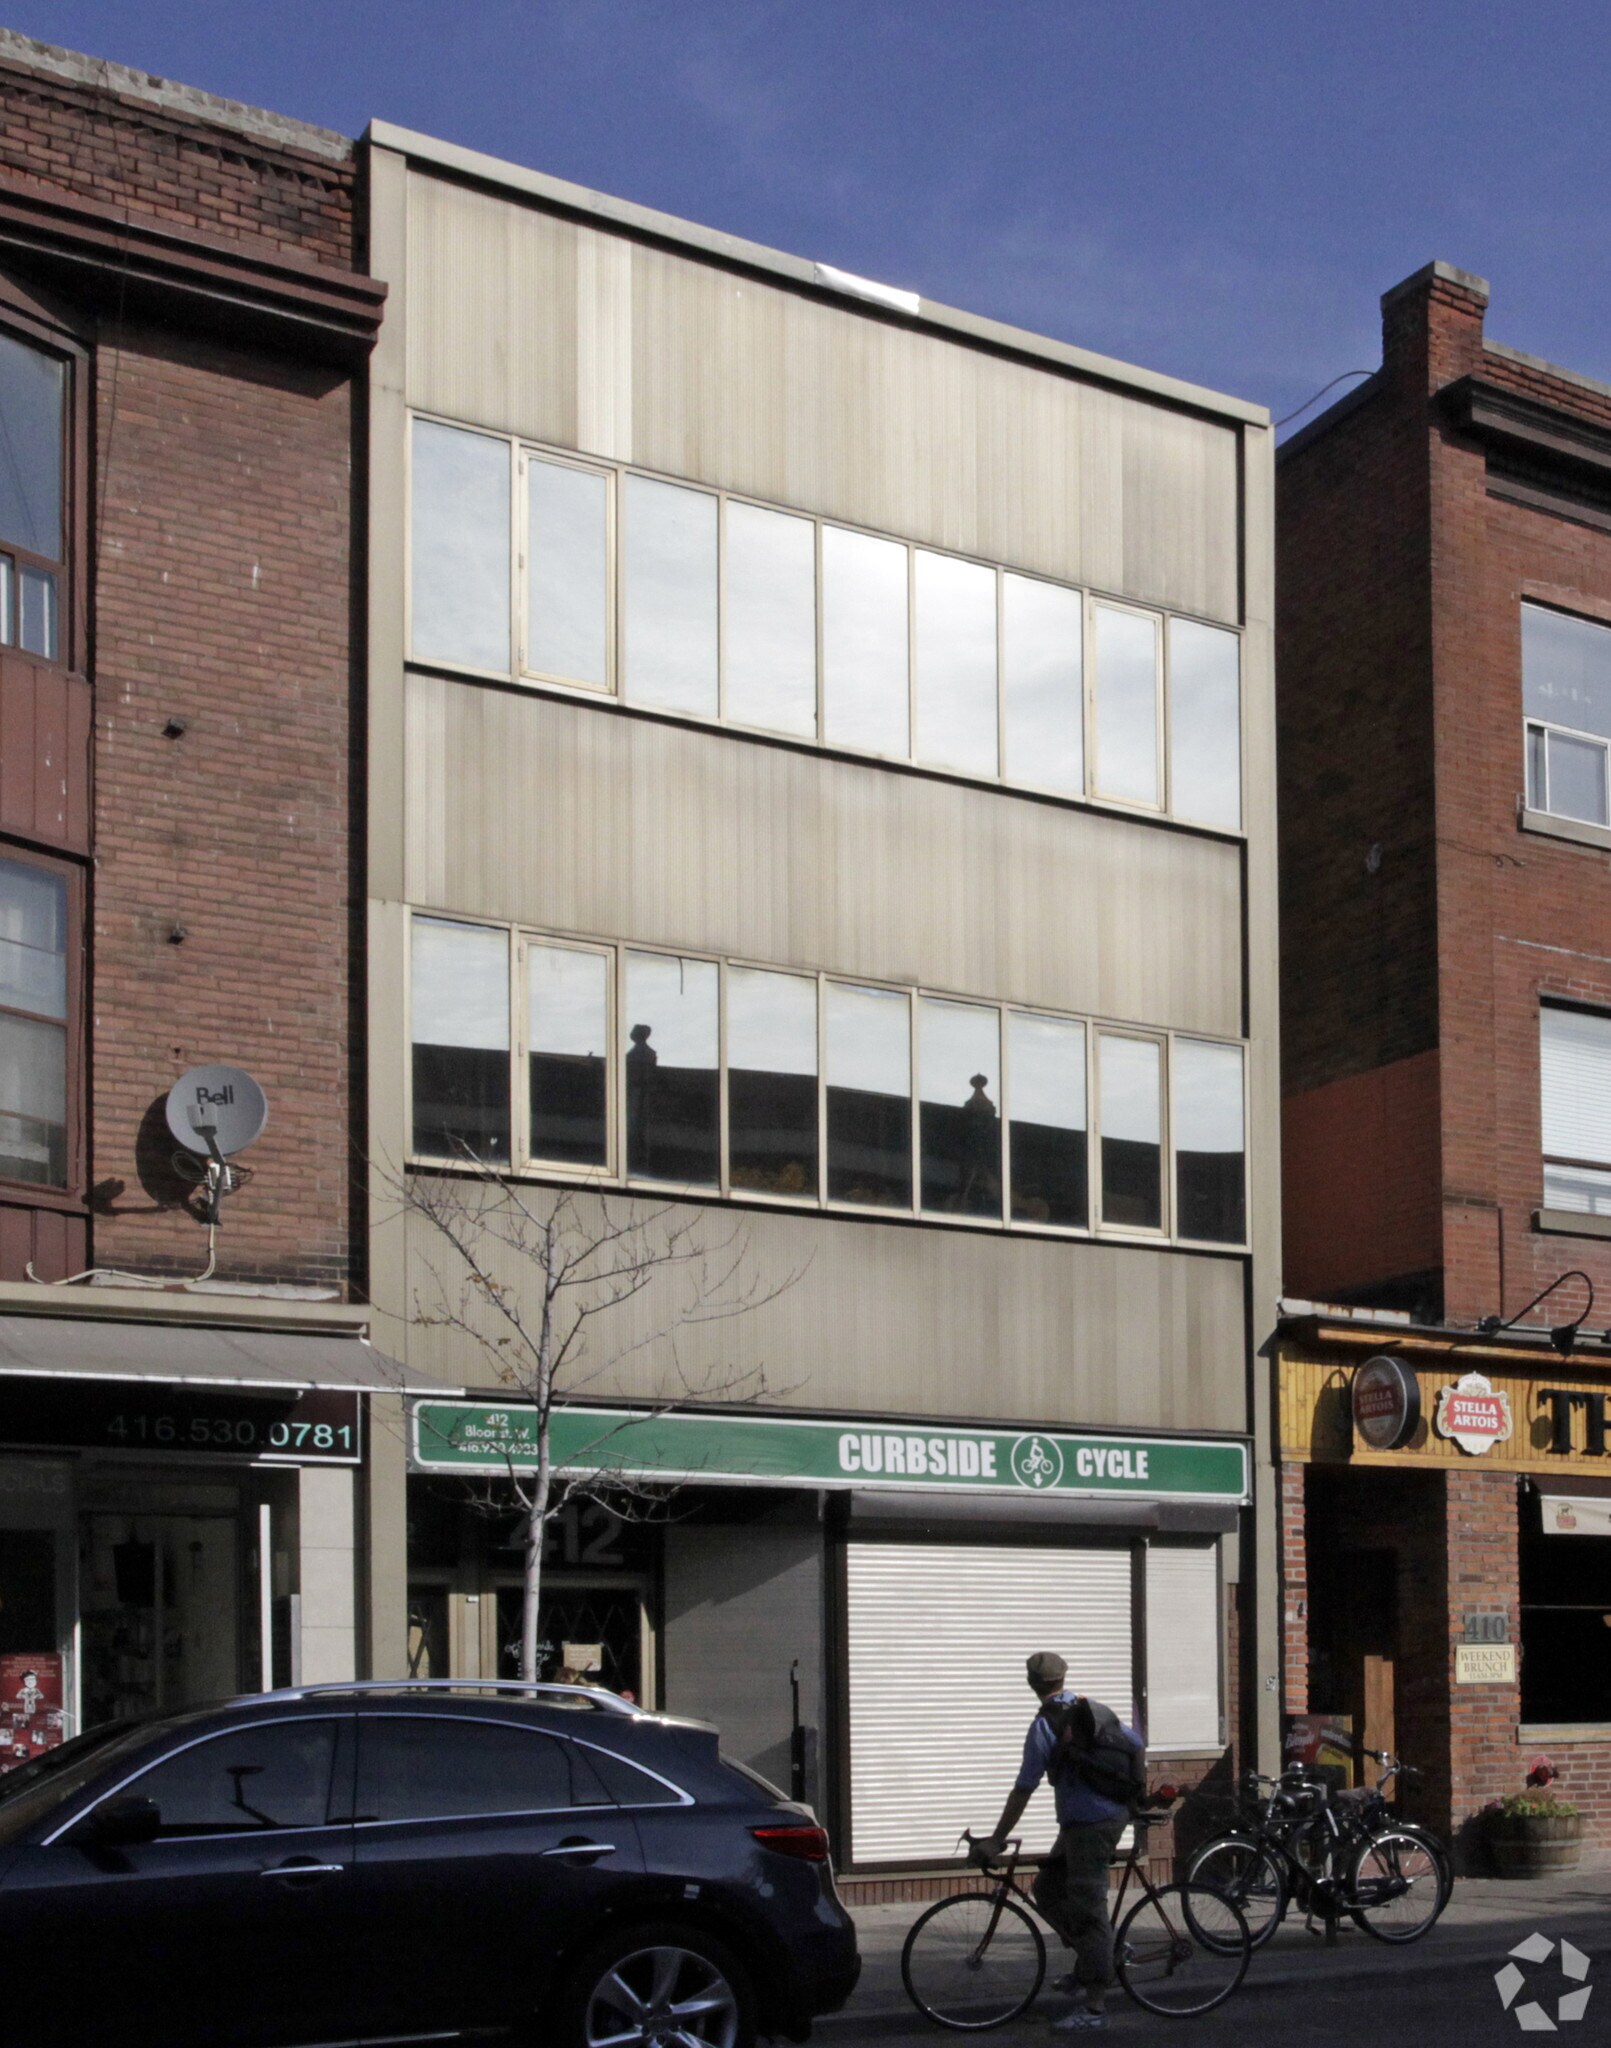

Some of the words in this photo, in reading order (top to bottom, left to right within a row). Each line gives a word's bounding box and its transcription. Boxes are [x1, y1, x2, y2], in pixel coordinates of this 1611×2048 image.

[196, 1085, 234, 1105] Bell
[1359, 1389, 1392, 1404] STELLA
[1359, 1400, 1394, 1414] ARTOIS
[1453, 1400, 1497, 1415] STELLA
[485, 1413, 508, 1427] 412
[1453, 1415, 1498, 1429] ARTOIS
[106, 1414, 351, 1449] 416.530.0781
[464, 1425, 496, 1438] Bloor
[458, 1440, 538, 1456] 416.9204933
[838, 1433, 997, 1478] CURBSIDE
[1076, 1447, 1149, 1480] CYCLE
[509, 1502, 624, 1565] 412
[1467, 1615, 1506, 1641] 410
[1460, 1650, 1511, 1662] WEEKEND
[1463, 1661, 1508, 1673] BRUNCH
